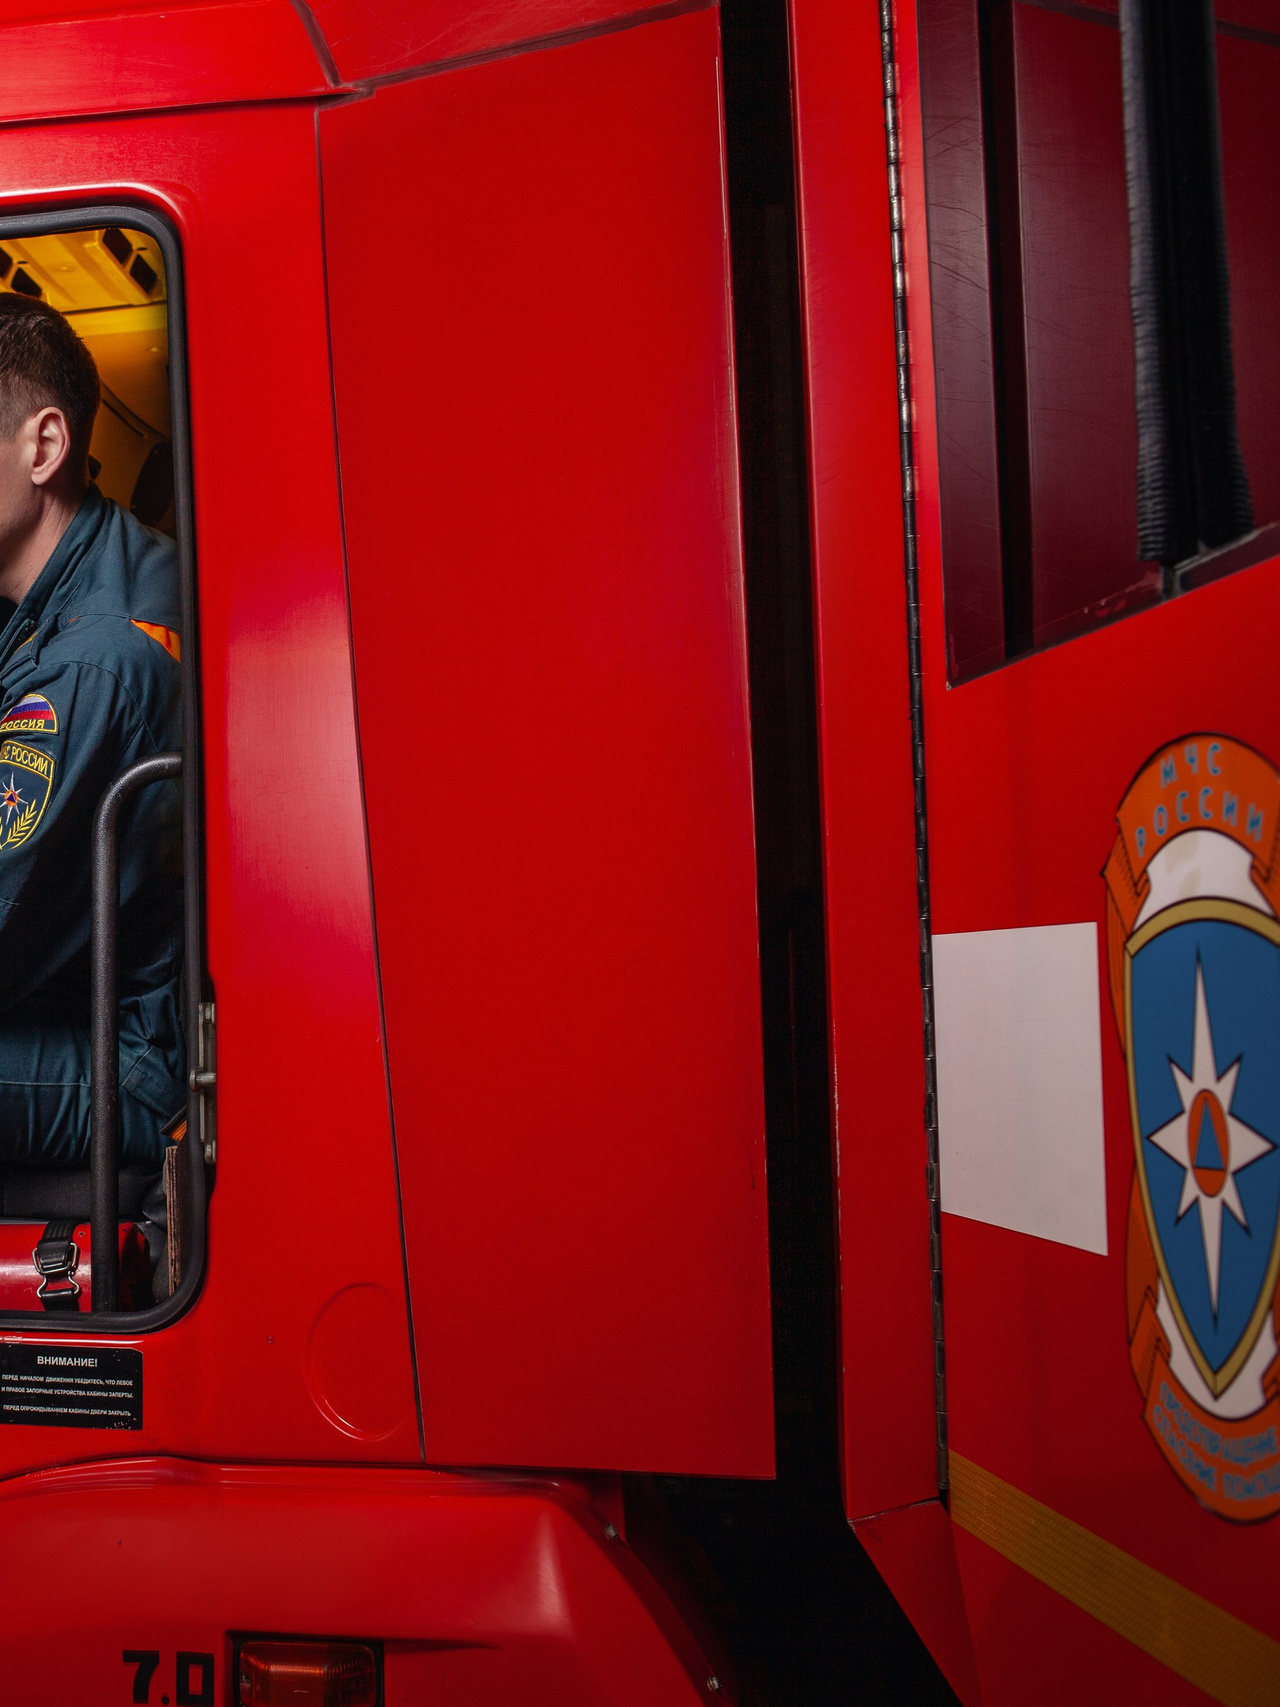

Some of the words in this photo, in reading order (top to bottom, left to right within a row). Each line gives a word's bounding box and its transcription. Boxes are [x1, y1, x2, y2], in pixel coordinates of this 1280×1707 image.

[0, 719, 45, 731] РОССИЯ
[10, 746, 48, 775] РОССИИ
[1161, 743, 1221, 789] МЧС
[1136, 786, 1264, 858] РОССИИ
[37, 1356, 98, 1367] ВНИМАНИЕ!
[122, 1650, 214, 1706] 7.0
